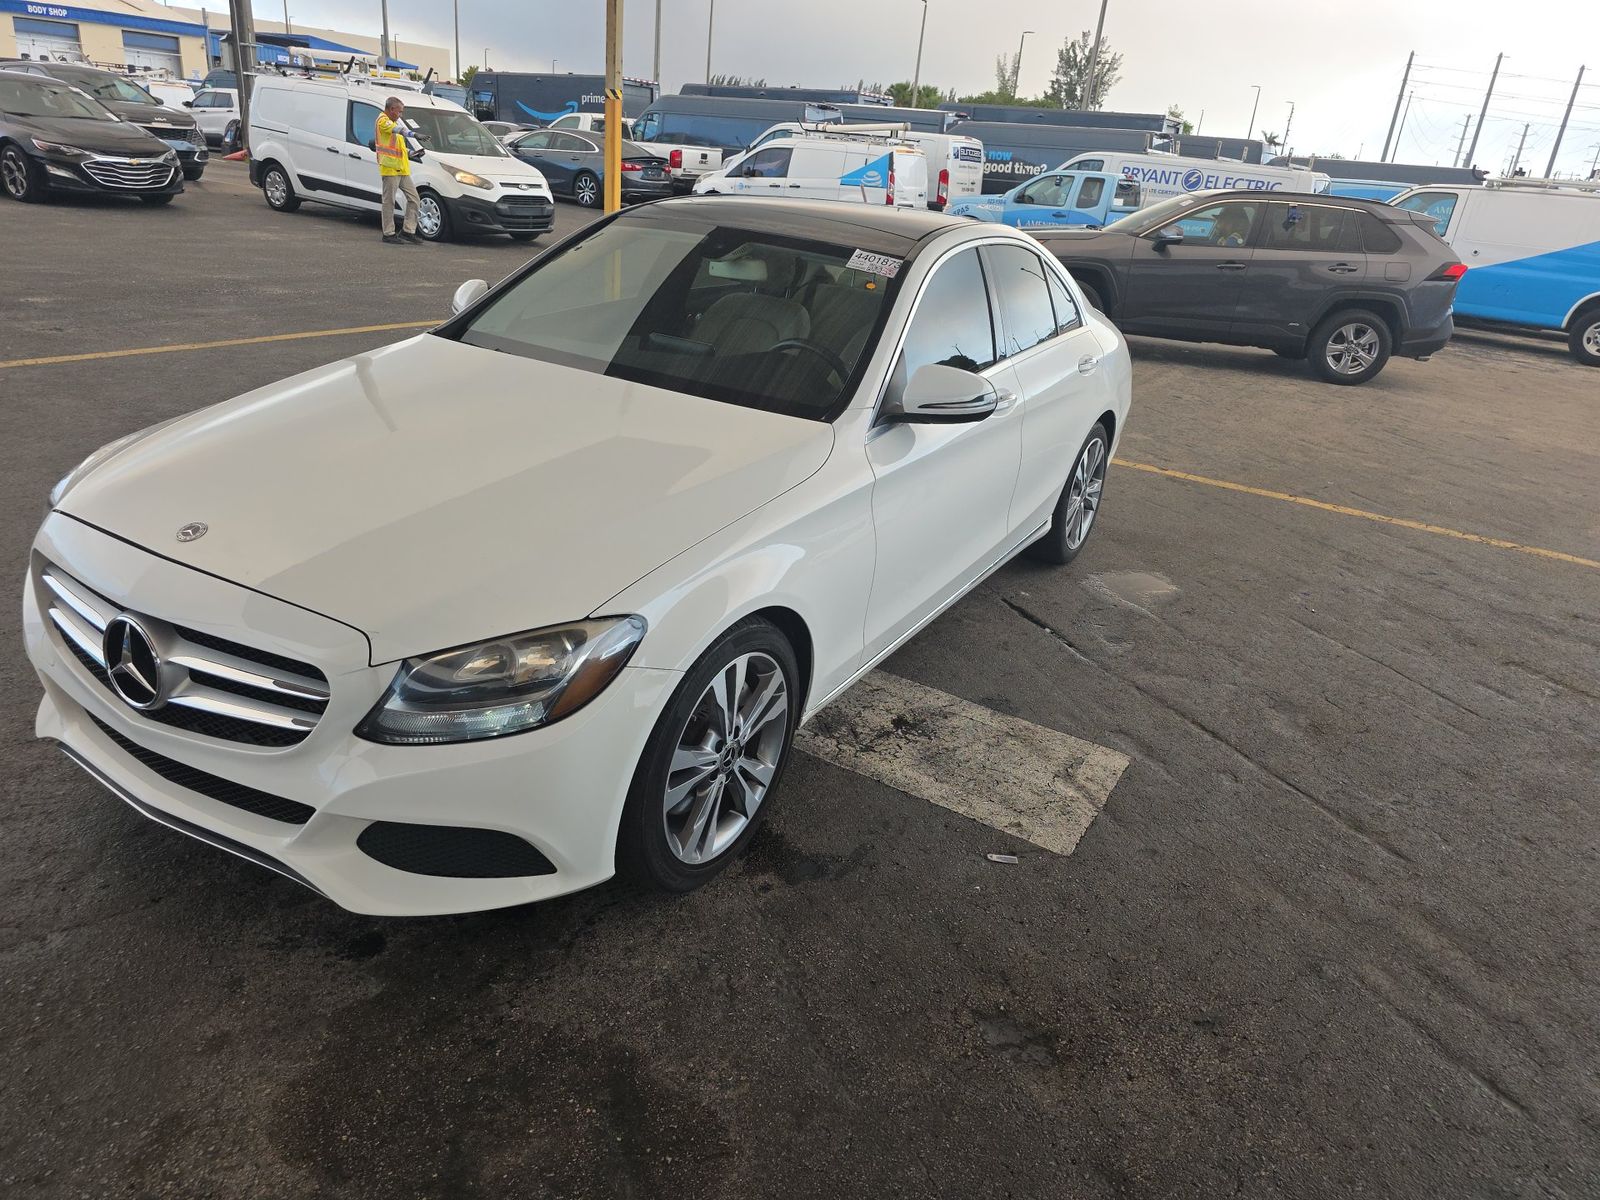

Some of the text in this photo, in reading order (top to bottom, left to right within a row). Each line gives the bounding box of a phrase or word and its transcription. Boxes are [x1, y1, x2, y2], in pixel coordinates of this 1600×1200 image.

[27, 4, 68, 17] BODY SHOP
[581, 92, 606, 105] prime
[989, 151, 1013, 161] now
[984, 162, 1048, 175] good time?
[1121, 166, 1282, 190] BRYANT ELECTRIC
[855, 252, 902, 269] 4401873
